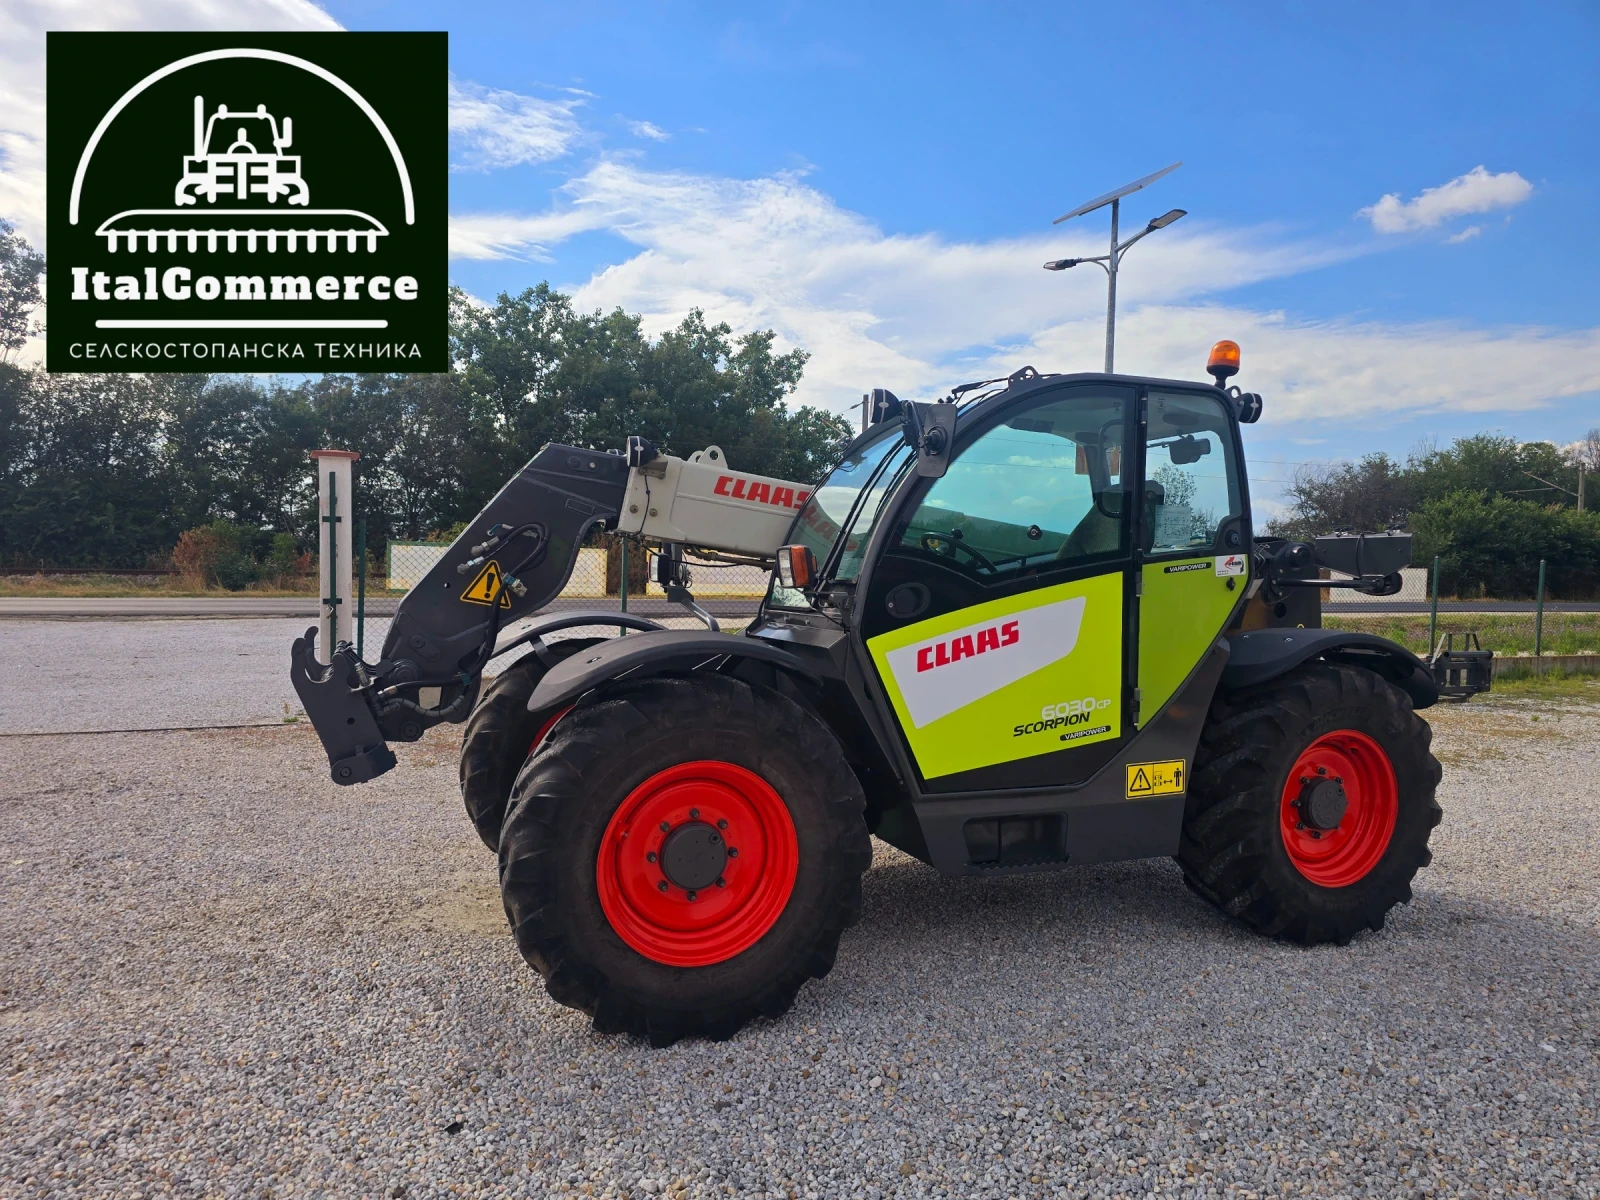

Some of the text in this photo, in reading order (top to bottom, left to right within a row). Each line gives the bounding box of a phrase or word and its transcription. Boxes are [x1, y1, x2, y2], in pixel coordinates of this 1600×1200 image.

[1169, 563, 1207, 573] VARIPOWER
[917, 620, 1019, 673] CLAAS
[1013, 711, 1091, 737] SCORPION
[1064, 726, 1107, 740] VARIPOWER
